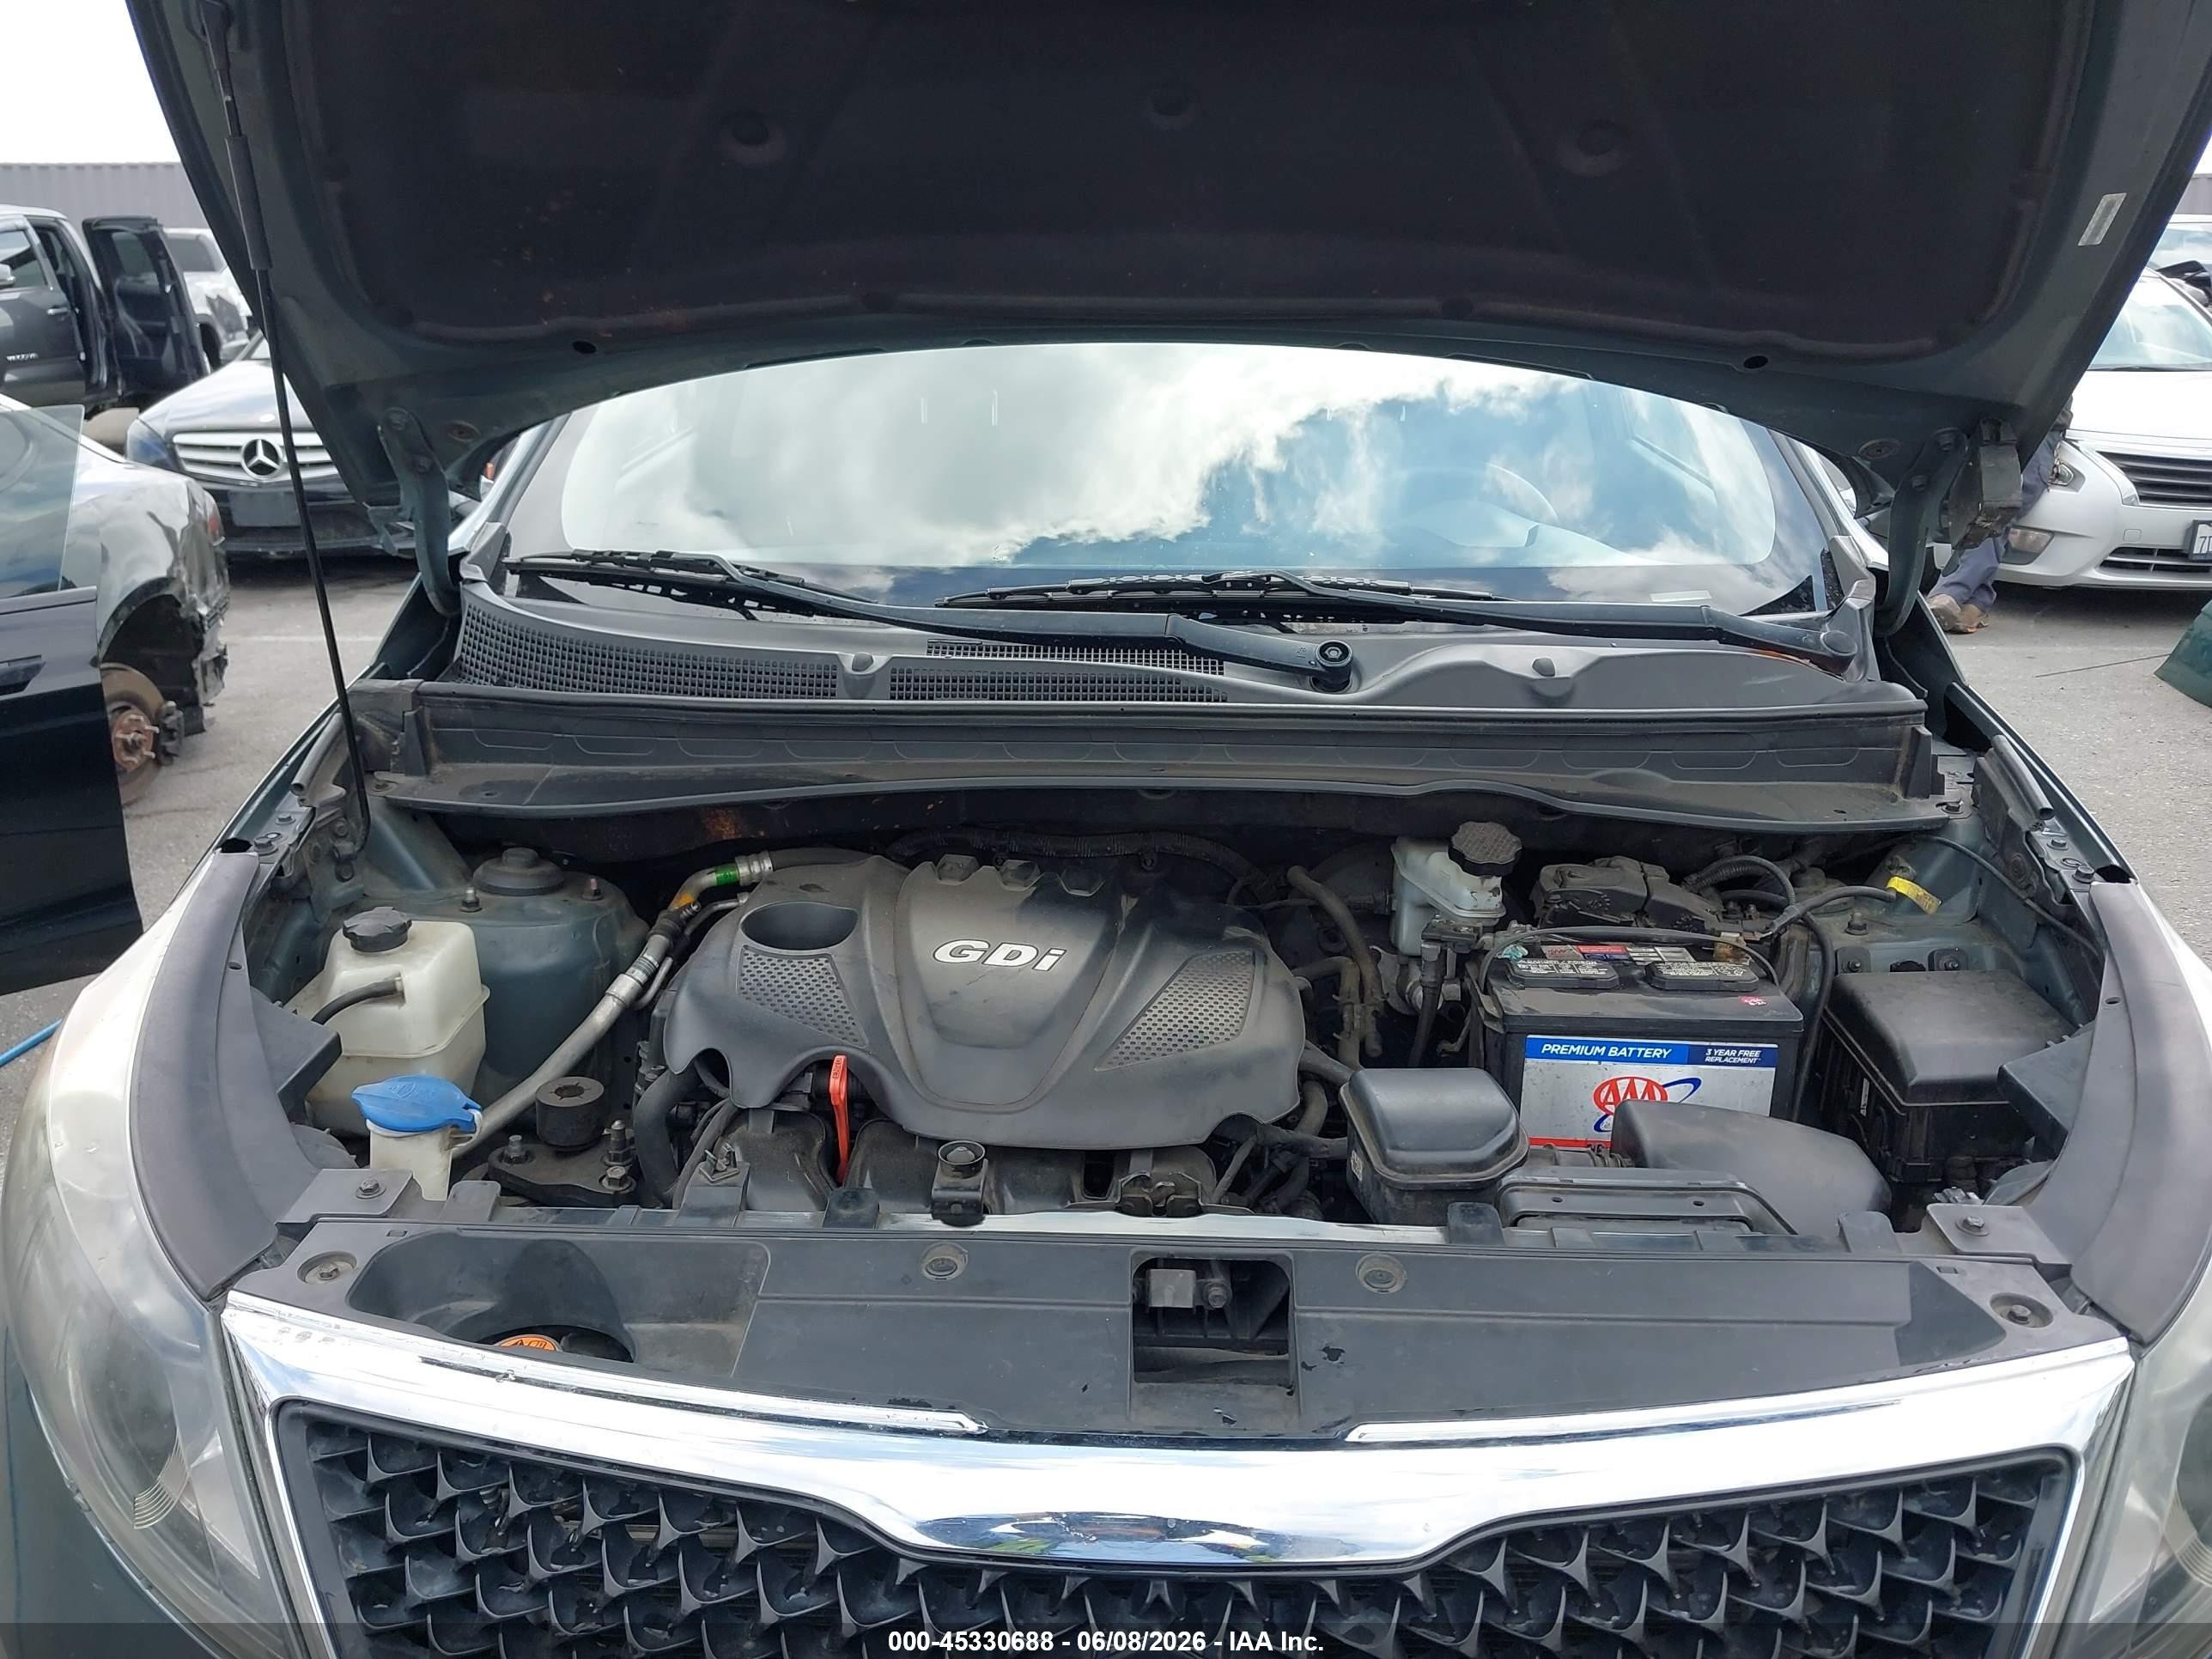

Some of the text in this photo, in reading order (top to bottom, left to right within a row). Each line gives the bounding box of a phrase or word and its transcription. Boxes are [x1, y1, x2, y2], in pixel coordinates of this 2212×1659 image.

[933, 939, 1067, 971] GDi
[1541, 1044, 1672, 1059] PREMIUM BATTERY
